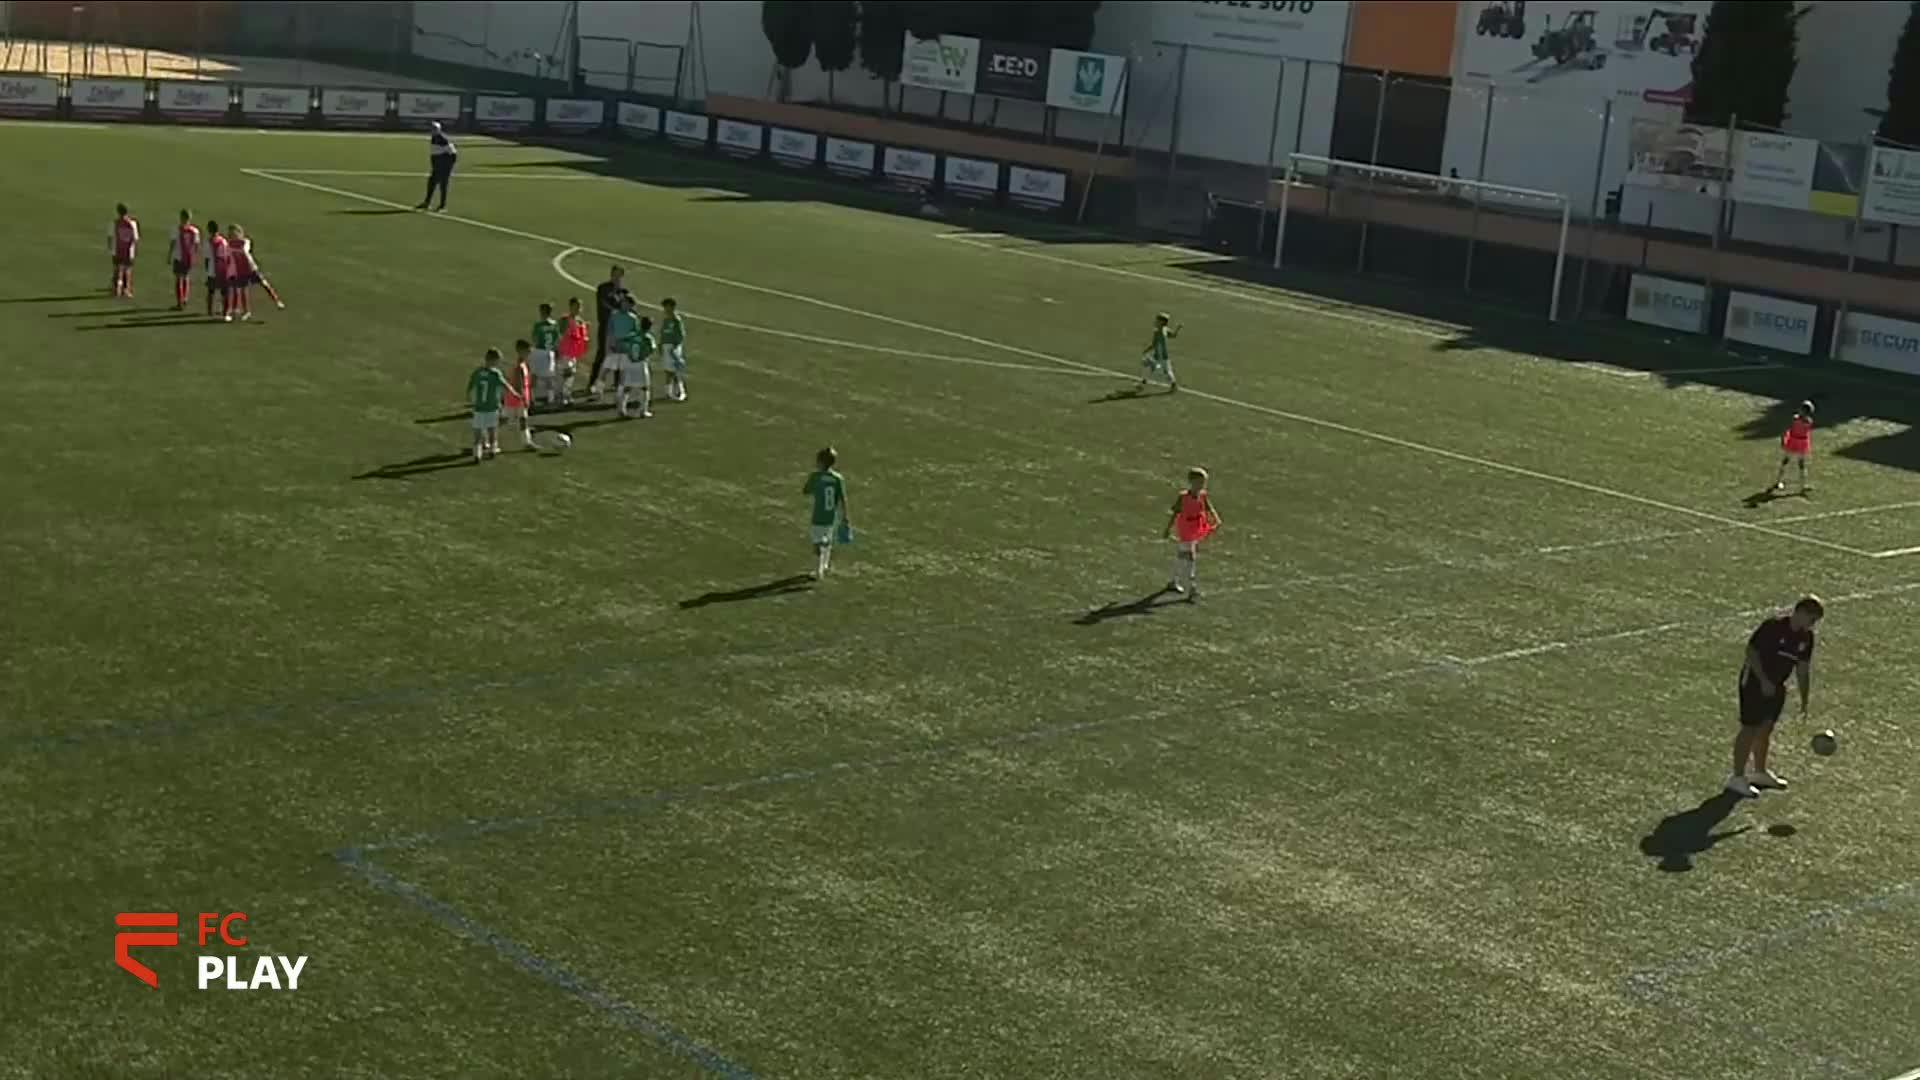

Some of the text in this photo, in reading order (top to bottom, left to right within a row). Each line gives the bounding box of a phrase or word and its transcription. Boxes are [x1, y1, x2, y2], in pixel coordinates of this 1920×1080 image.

[1754, 311, 1808, 334] SECUR
[479, 380, 489, 402] 7
[824, 486, 835, 511] 8
